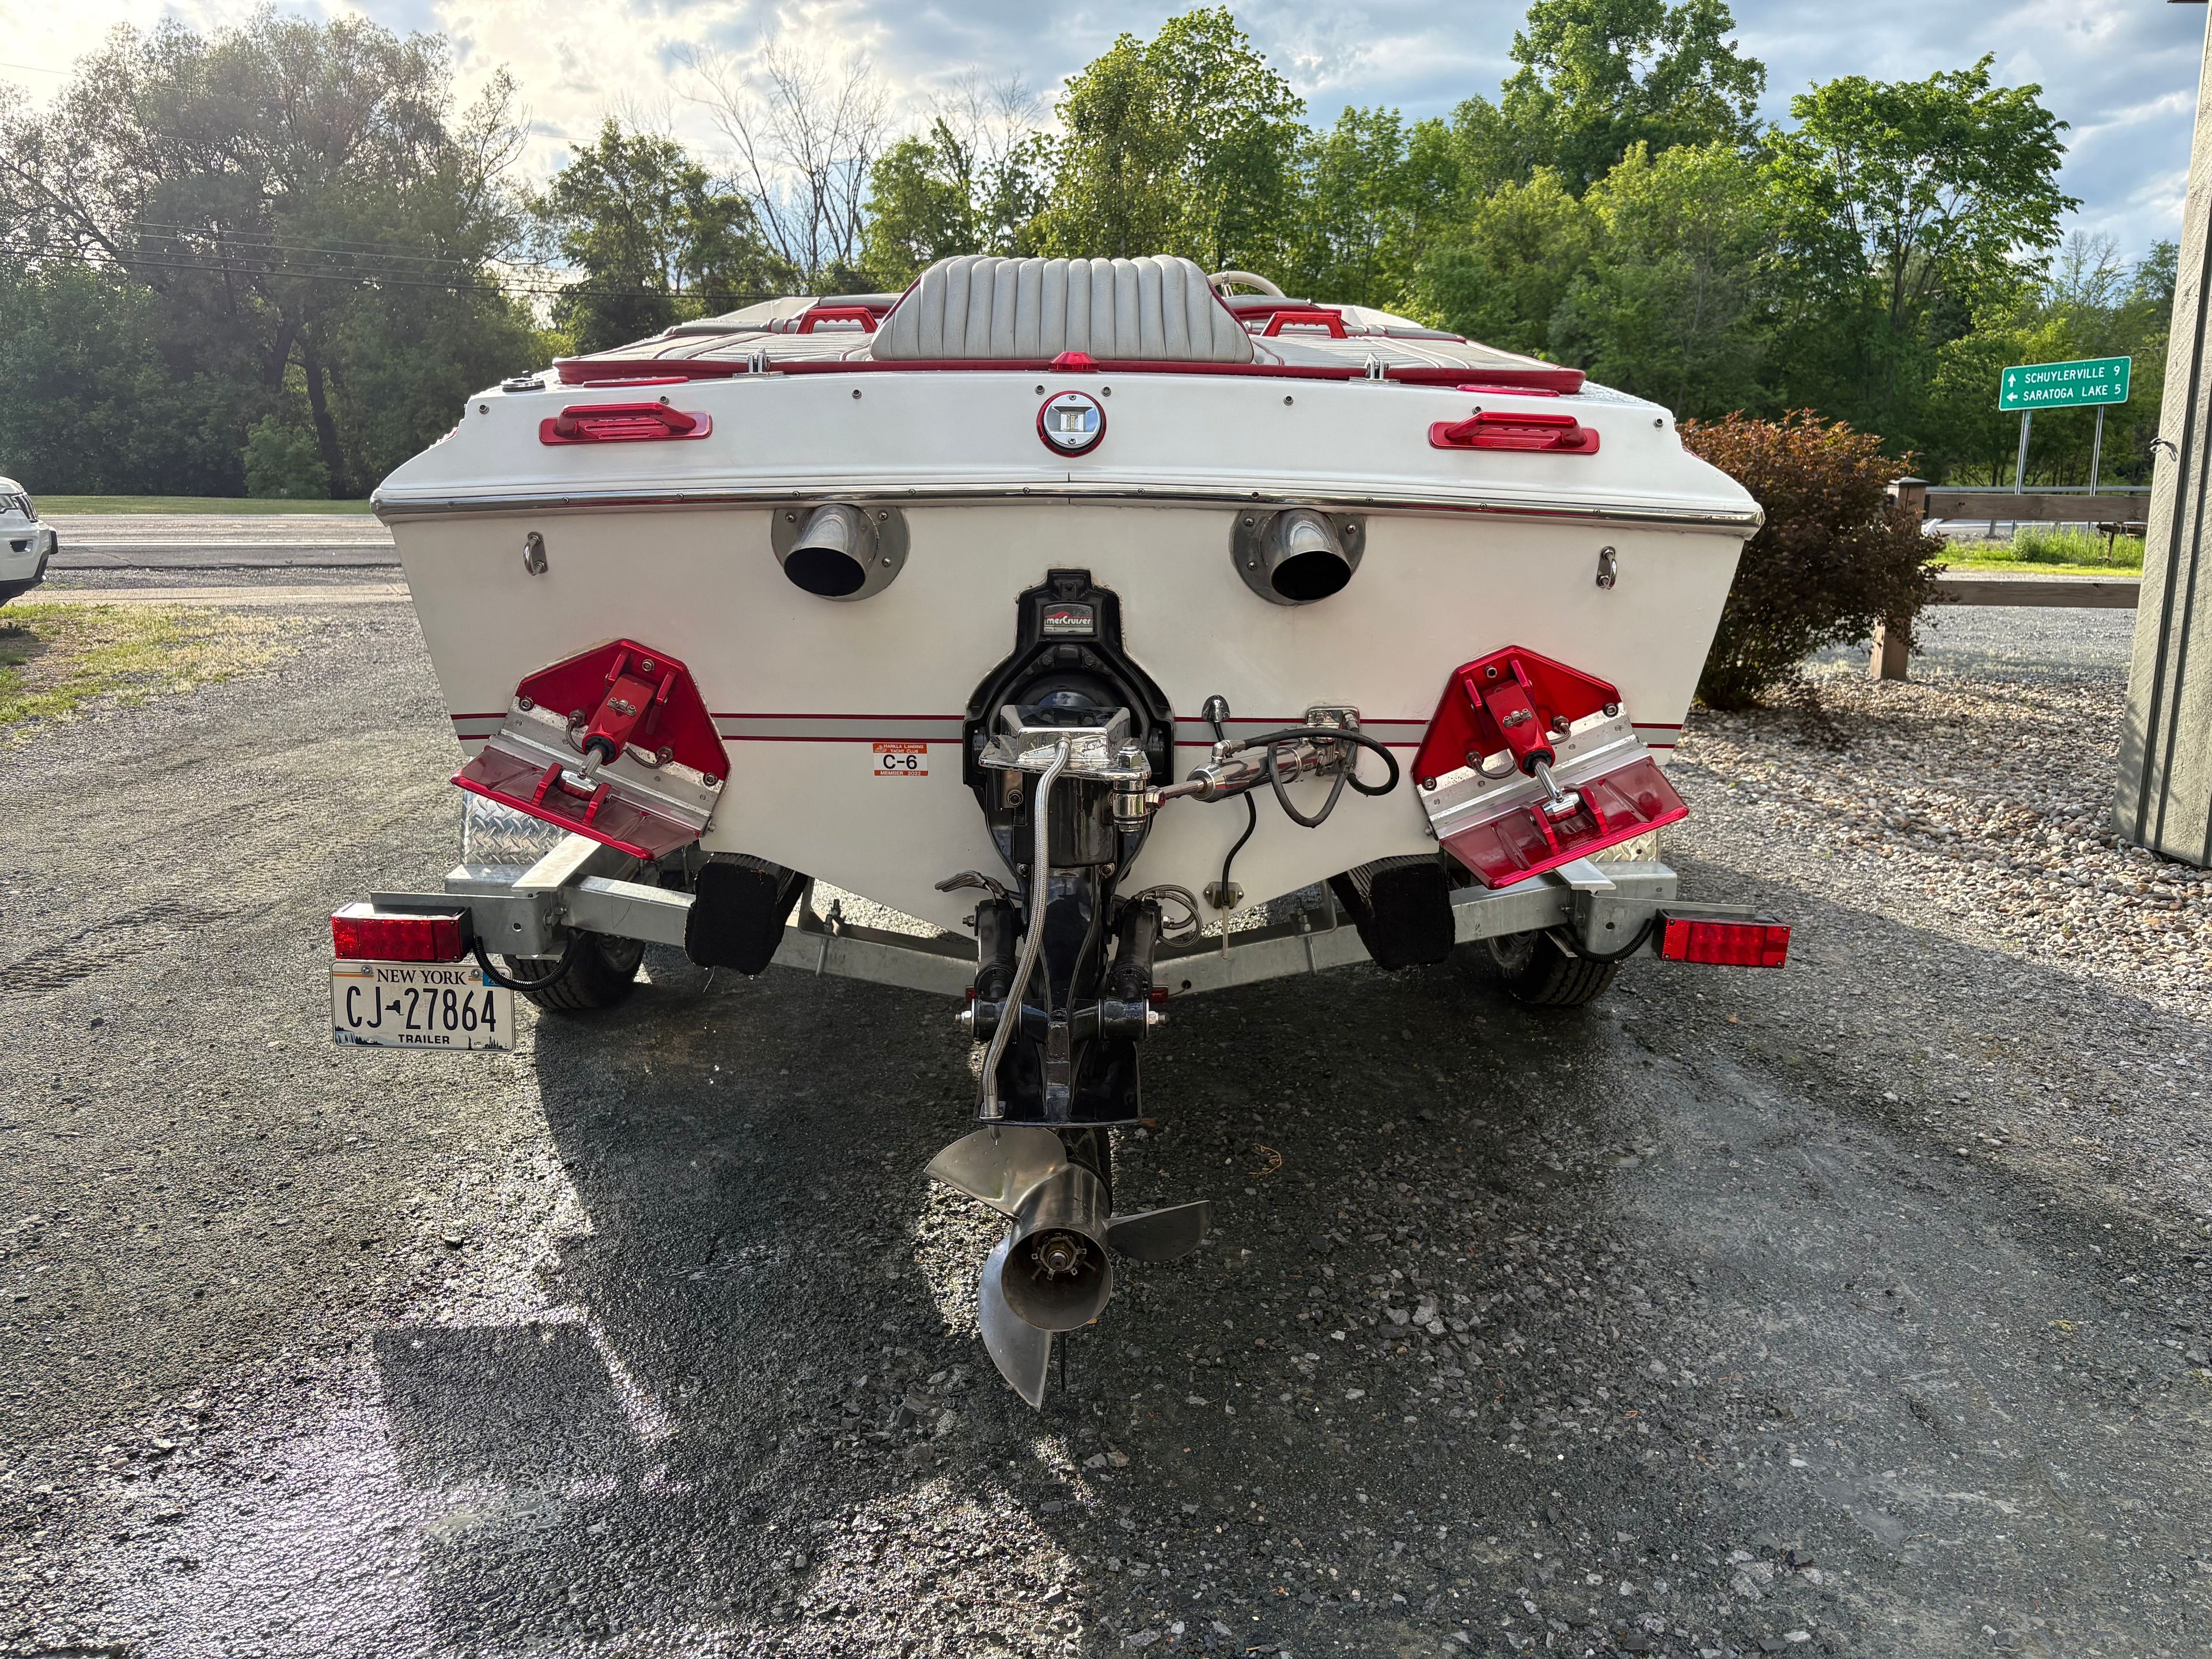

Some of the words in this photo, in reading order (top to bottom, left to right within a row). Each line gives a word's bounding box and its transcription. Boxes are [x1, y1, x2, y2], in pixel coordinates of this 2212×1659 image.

[2025, 367, 2105, 384] SCHUYLERVILLE
[2113, 365, 2120, 376] 9
[2023, 388, 2074, 401] SARATOGA
[2082, 385, 2108, 397] LAKE
[2114, 384, 2121, 395] 5
[883, 754, 917, 770] C-6
[377, 968, 417, 983] NEW
[421, 970, 467, 985] YORK
[398, 1034, 450, 1044] TRAILER
